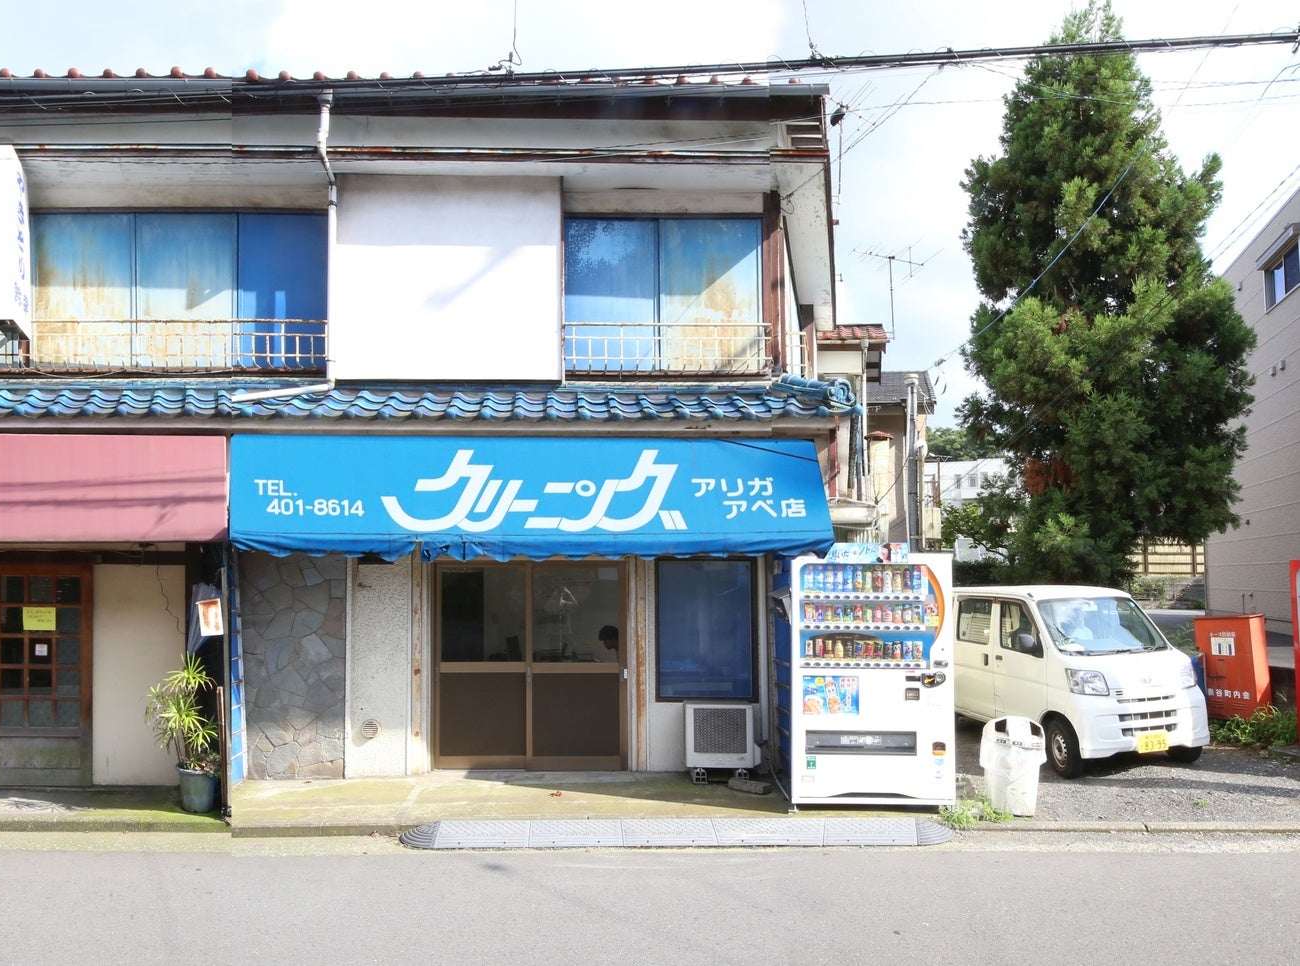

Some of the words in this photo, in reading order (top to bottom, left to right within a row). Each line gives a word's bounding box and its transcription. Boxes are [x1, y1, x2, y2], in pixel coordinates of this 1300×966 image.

[254, 479, 298, 497] TEL.
[380, 449, 689, 533] クリーニング
[691, 477, 774, 498] アリガ
[266, 498, 365, 517] 401-8614
[722, 498, 807, 520] アベ店
